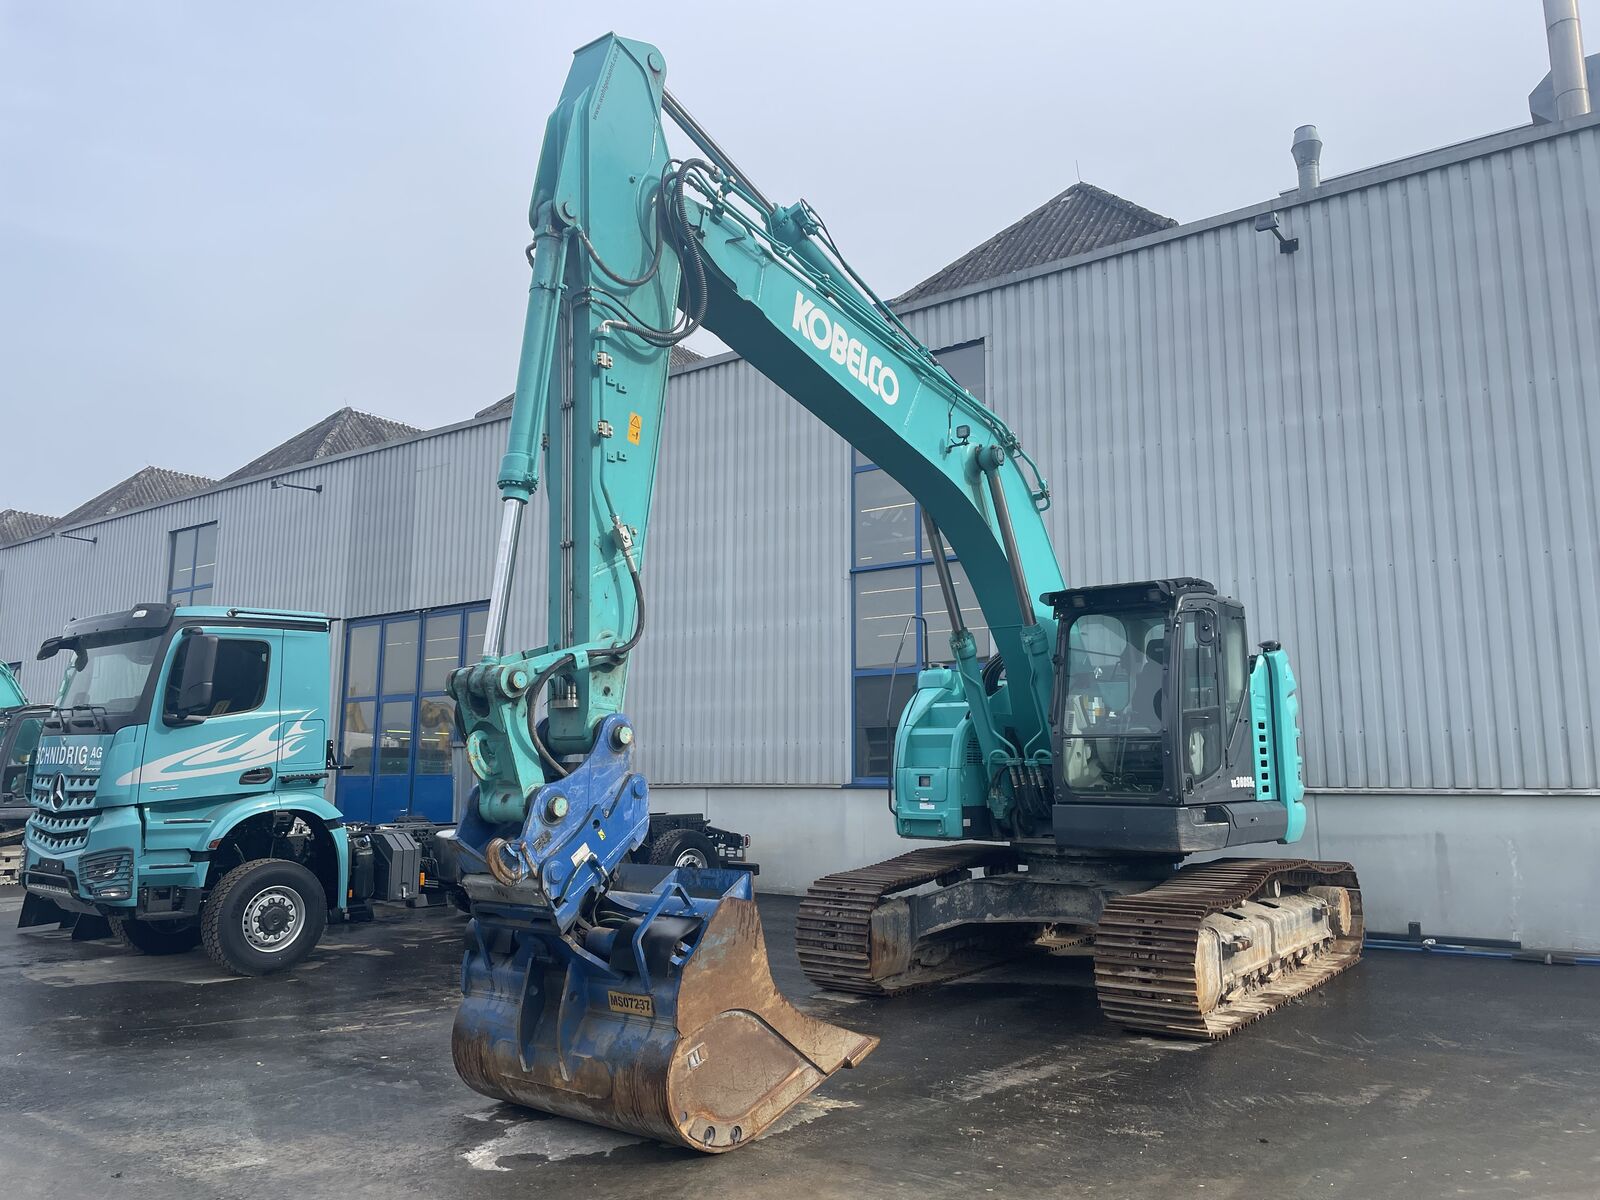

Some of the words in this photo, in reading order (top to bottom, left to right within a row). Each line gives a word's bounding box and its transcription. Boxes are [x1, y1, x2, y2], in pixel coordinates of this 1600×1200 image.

[792, 290, 899, 405] KOBELCO
[36, 746, 88, 765] SCHNIDRIG
[90, 747, 103, 758] AG
[610, 995, 650, 1011] MS07237
